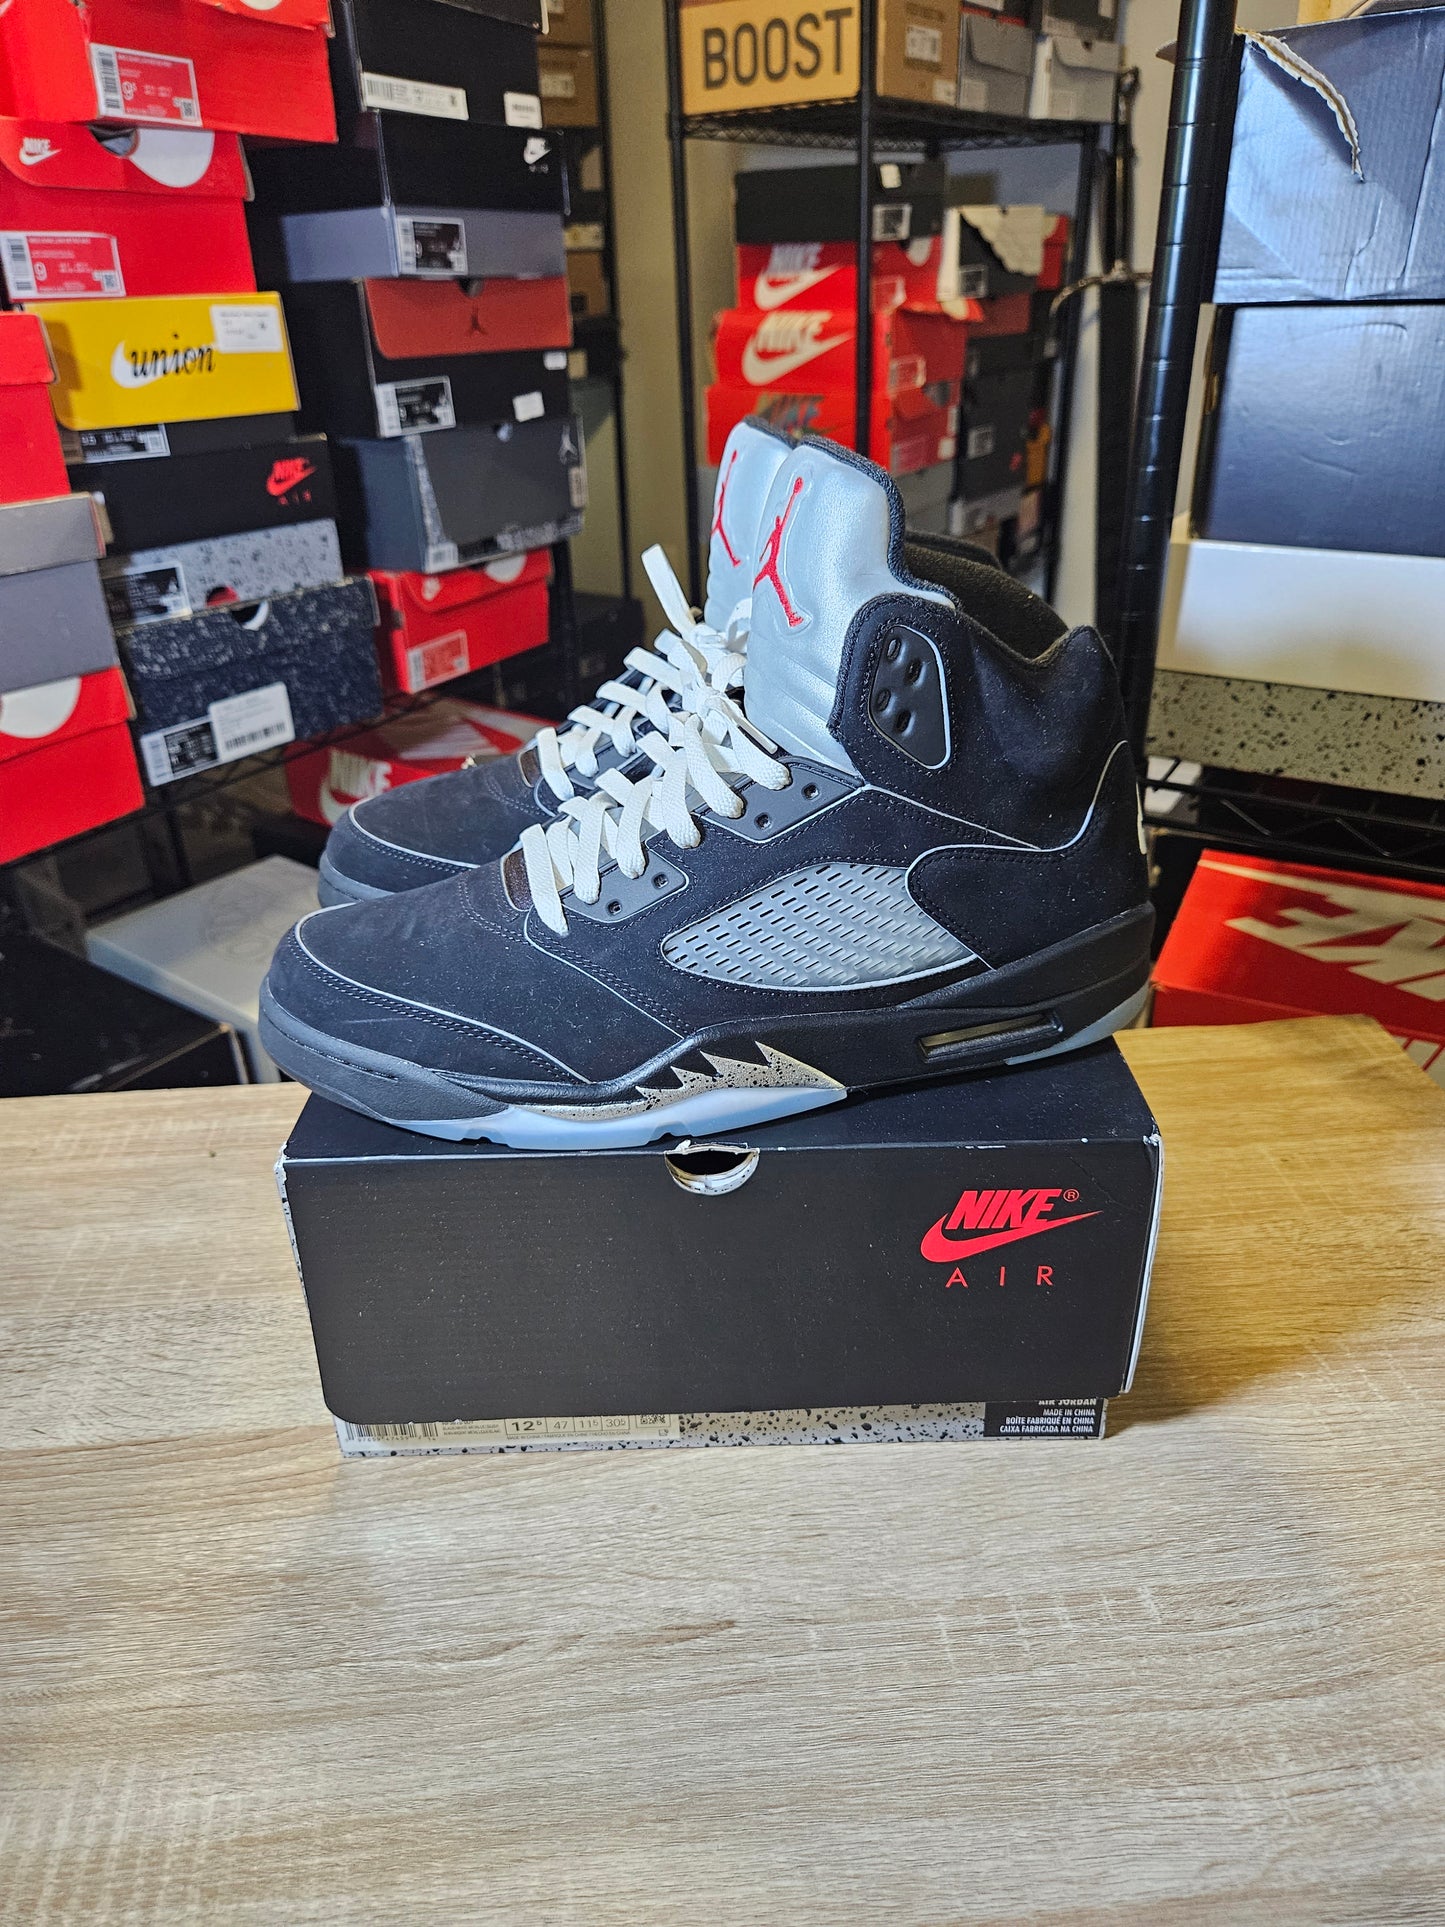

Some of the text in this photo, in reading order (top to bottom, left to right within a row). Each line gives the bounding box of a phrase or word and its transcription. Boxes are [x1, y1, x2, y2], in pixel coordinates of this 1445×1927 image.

[703, 9, 854, 90] BOOST
[757, 311, 833, 351] NIKE
[131, 333, 215, 377] union
[553, 1420, 568, 1430] 47
[1000, 1425, 1020, 1433] CAIXA
[1022, 1425, 1059, 1433] FABRICADA
